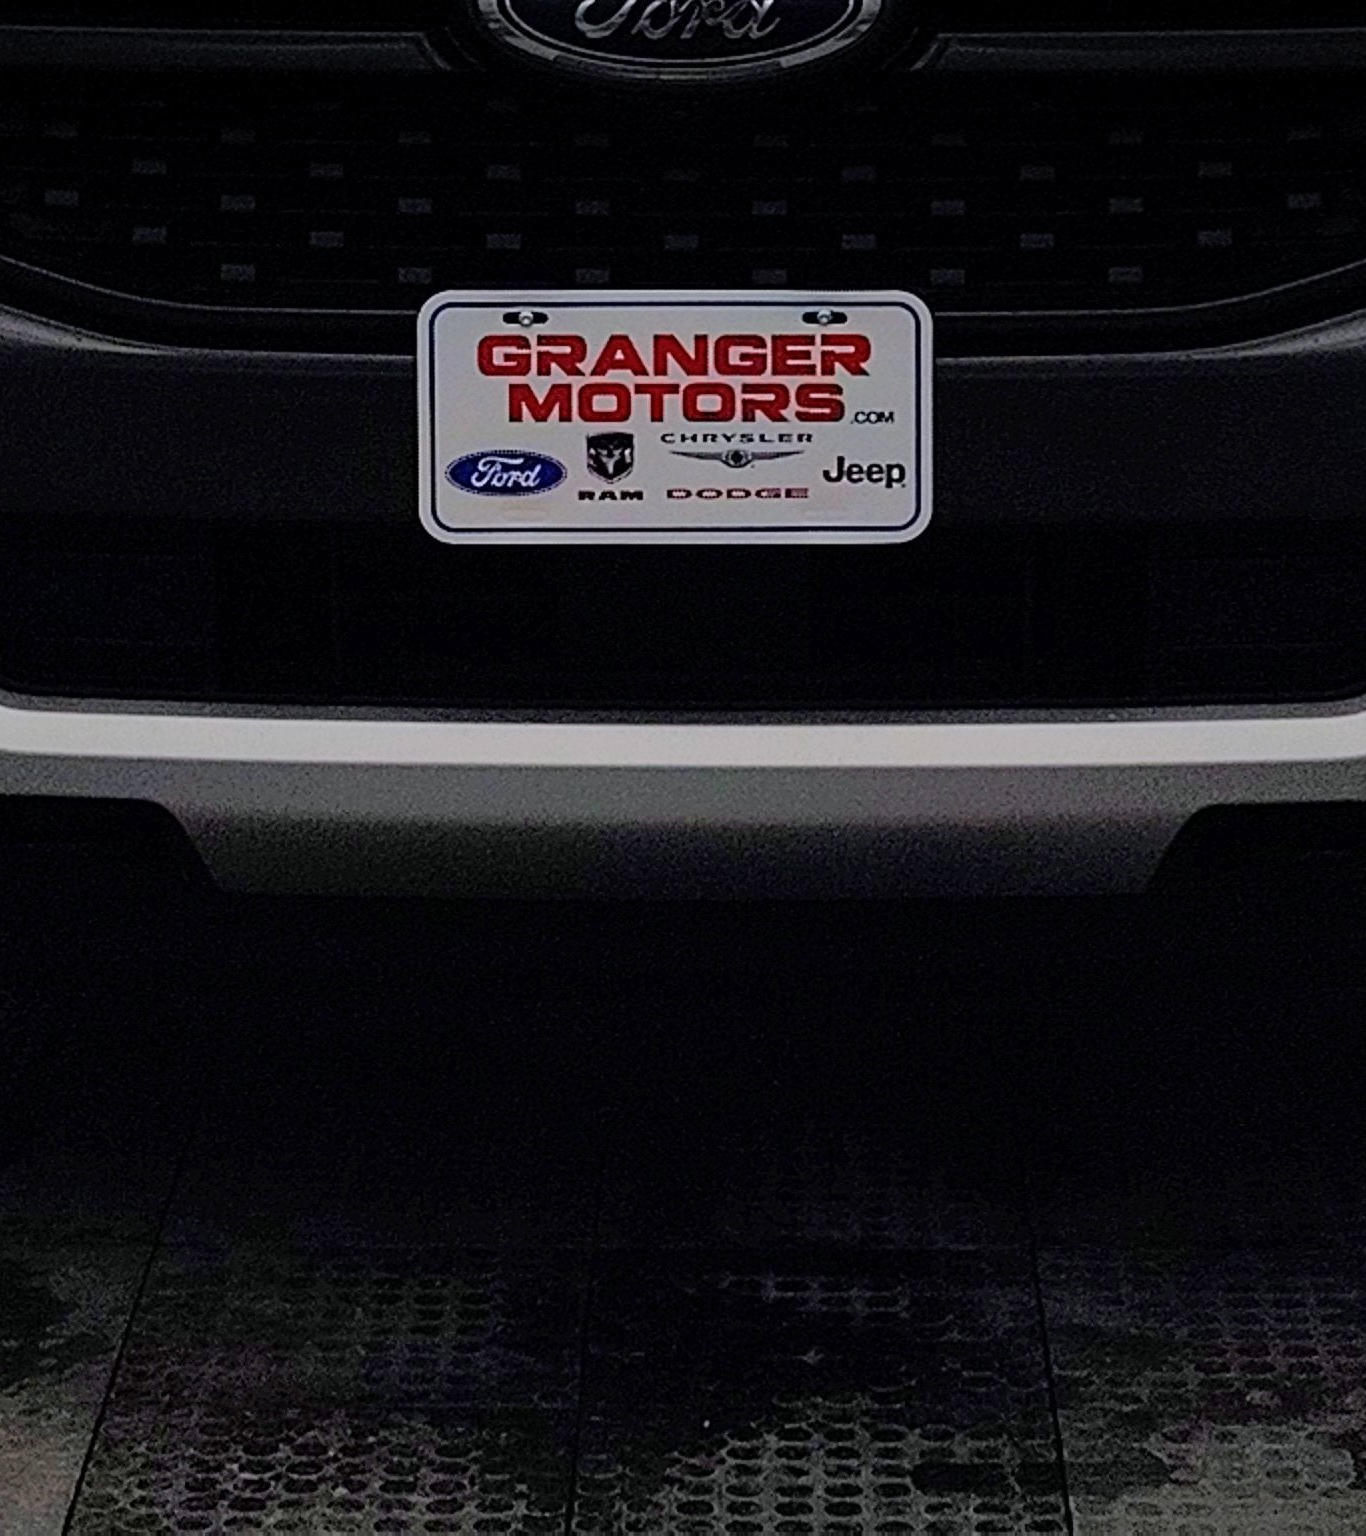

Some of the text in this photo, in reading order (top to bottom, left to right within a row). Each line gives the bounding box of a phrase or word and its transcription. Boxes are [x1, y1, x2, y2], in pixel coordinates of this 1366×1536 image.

[477, 333, 872, 377] GRANGER
[508, 383, 845, 423] MOTORS
[660, 433, 813, 444] CHRYSLER
[470, 456, 541, 488] Ford
[822, 456, 906, 488] Jeep
[578, 489, 644, 501] RAM
[666, 488, 809, 500] DODGE
